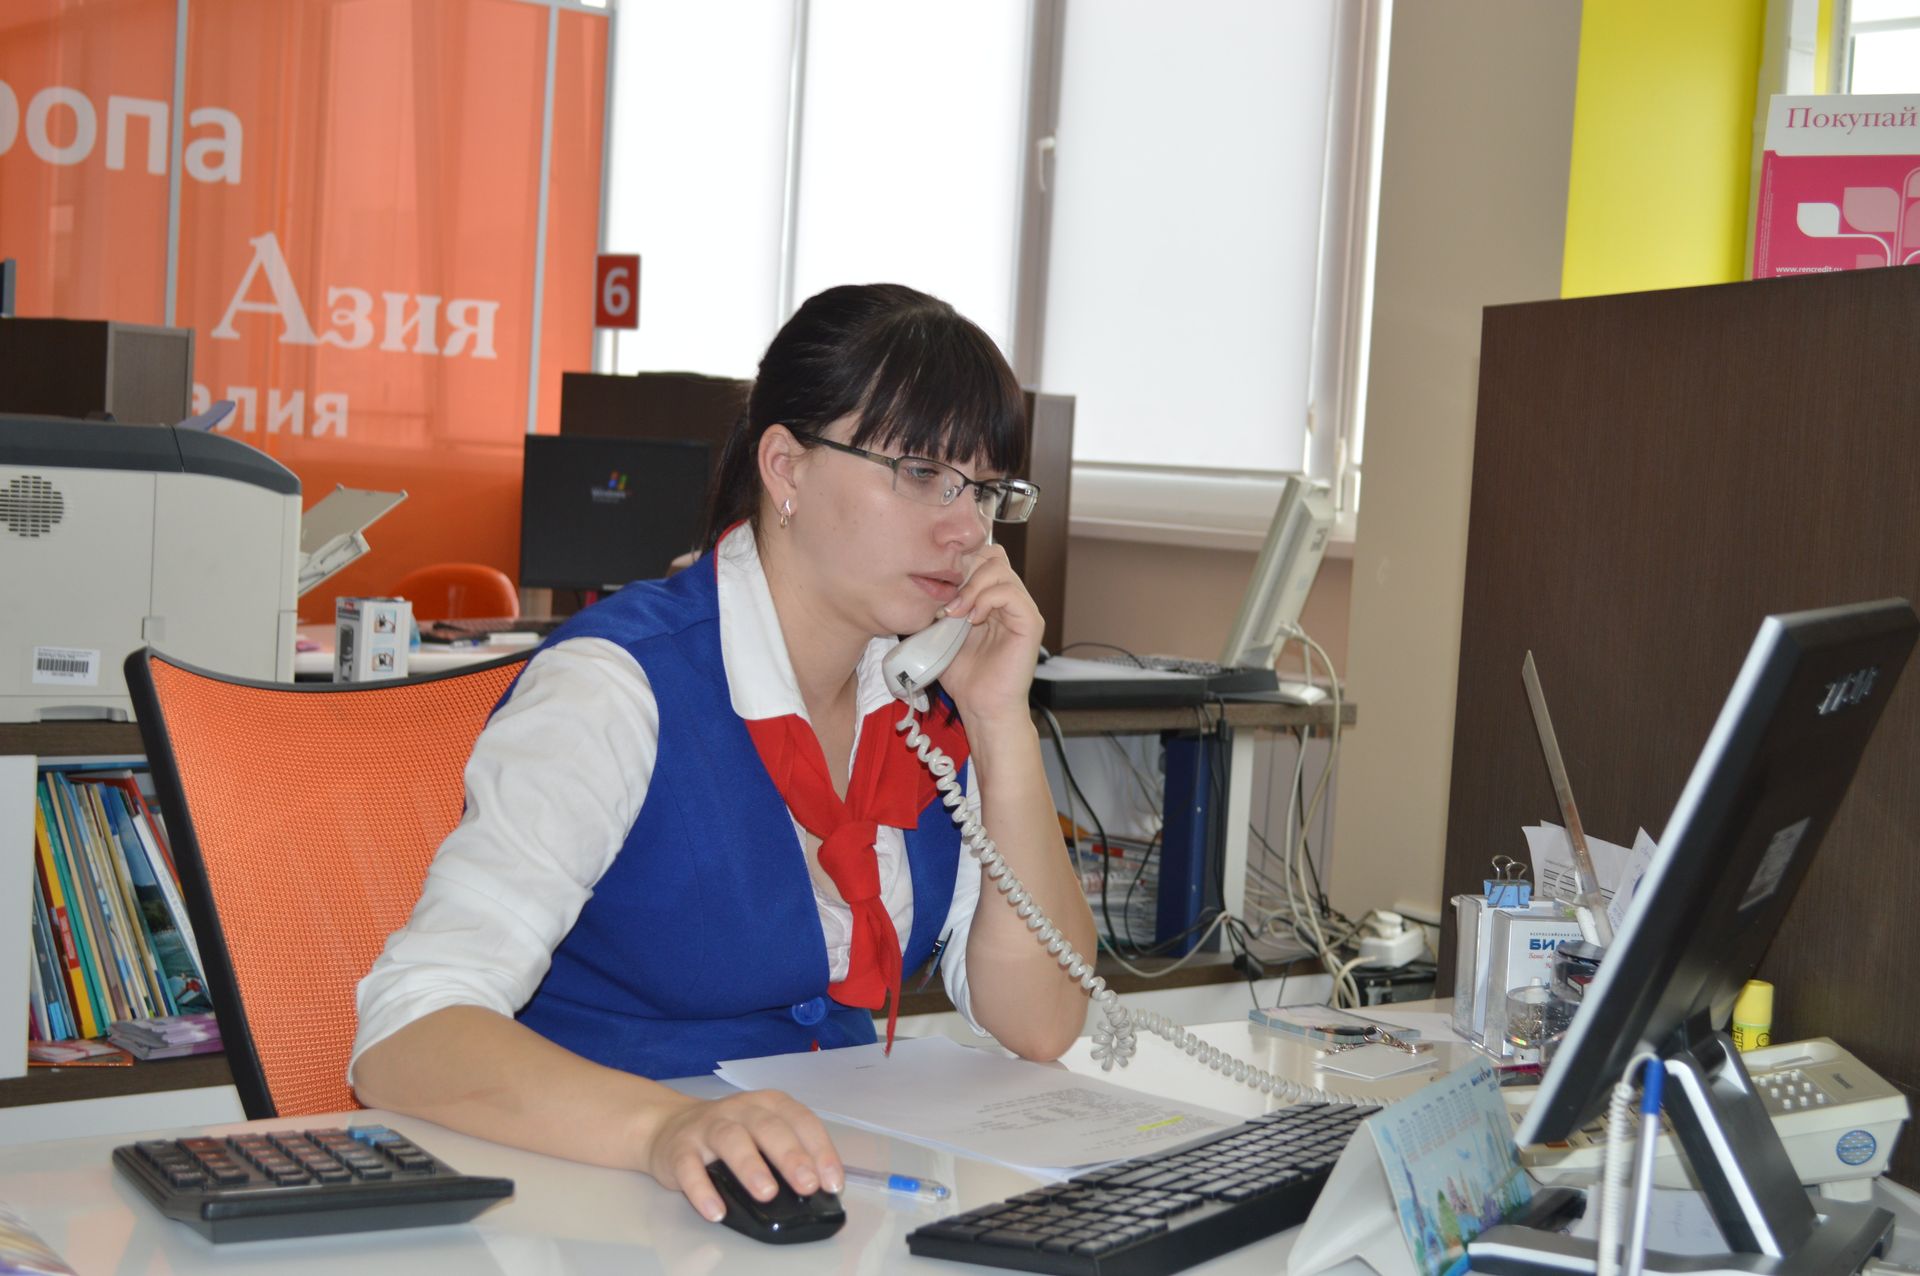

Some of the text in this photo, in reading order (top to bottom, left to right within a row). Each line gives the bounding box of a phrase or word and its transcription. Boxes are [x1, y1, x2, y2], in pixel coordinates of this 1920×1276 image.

[1787, 105, 1917, 135] Покупай
[211, 231, 500, 359] Азия
[603, 267, 630, 316] 6
